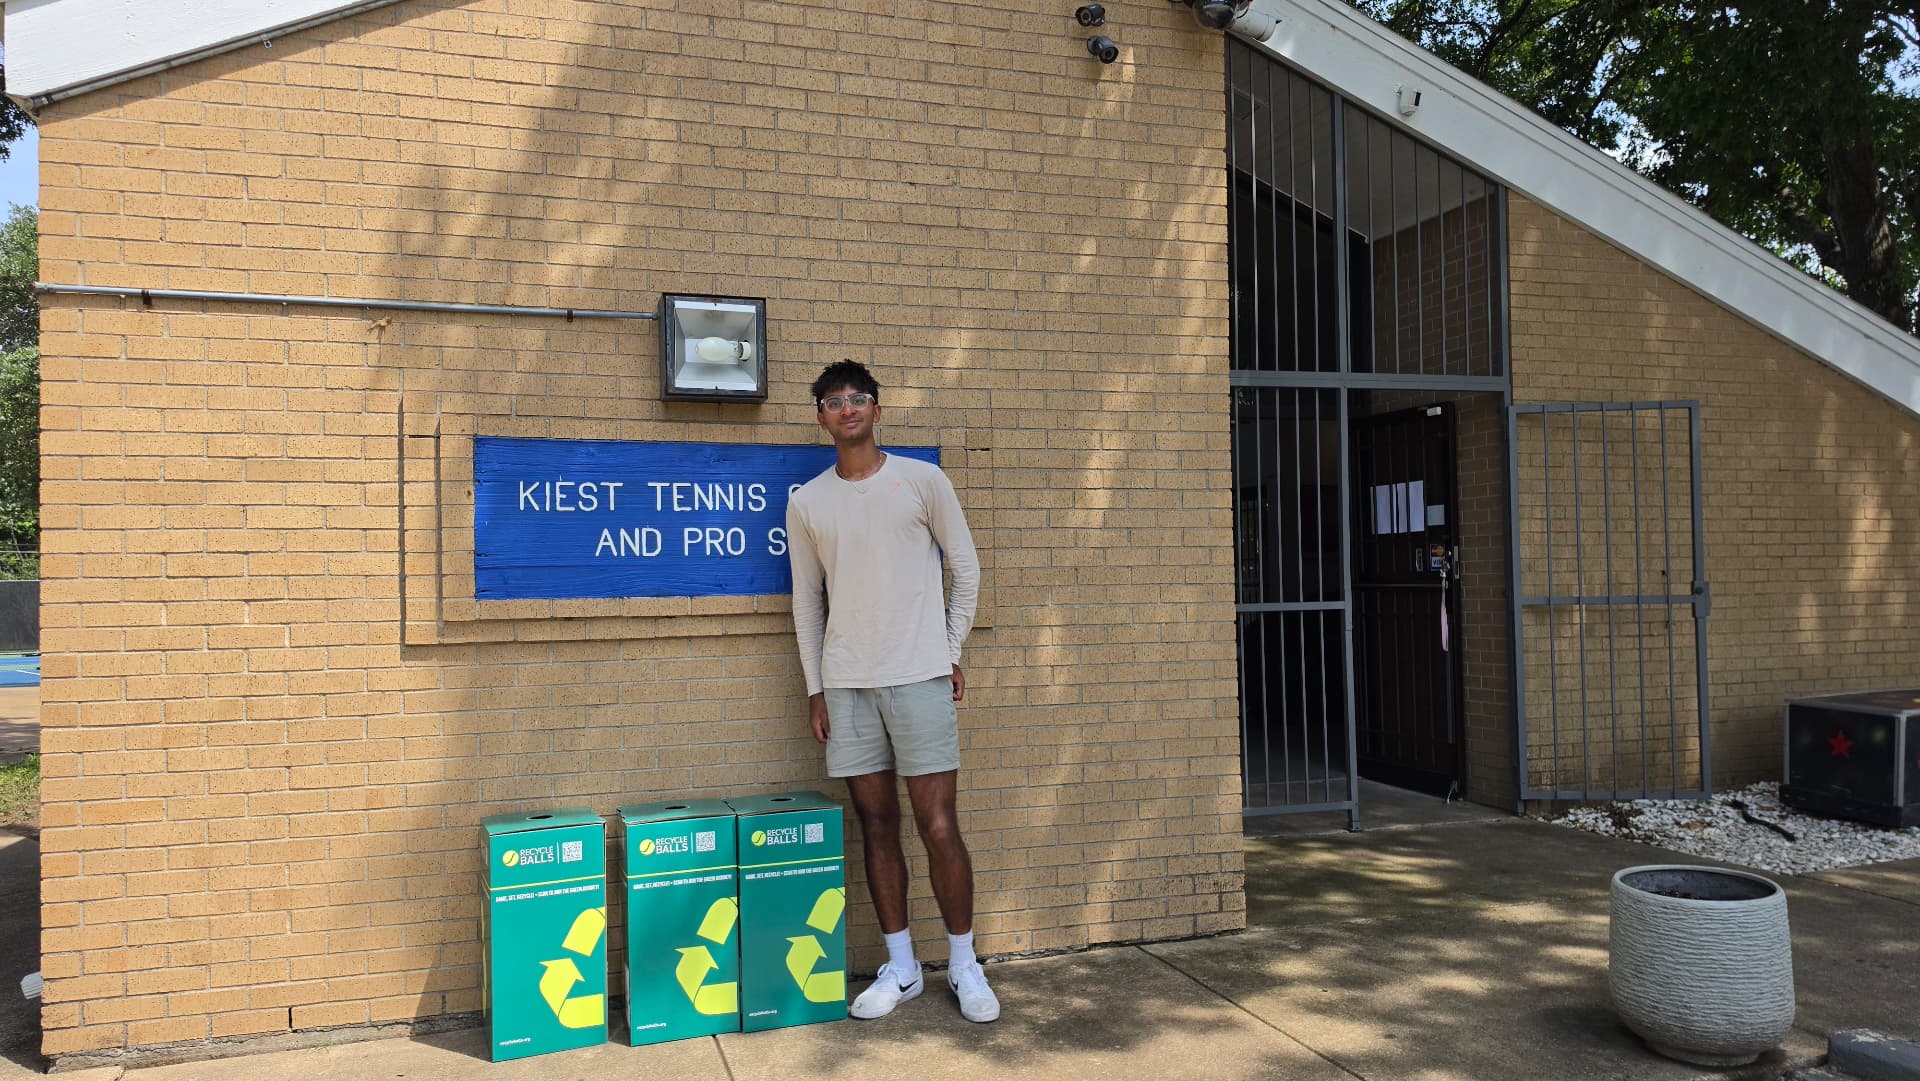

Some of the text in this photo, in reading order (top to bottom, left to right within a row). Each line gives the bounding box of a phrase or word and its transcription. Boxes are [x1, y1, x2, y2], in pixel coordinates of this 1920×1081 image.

[519, 480, 624, 512] KIEST
[647, 482, 767, 512] TENNIS
[595, 527, 662, 557] AND
[683, 526, 746, 557] PRO
[767, 827, 798, 837] RECYCLE
[655, 835, 688, 846] RECYCLE
[767, 834, 798, 846] BALLS
[520, 845, 553, 857] RECYCLE
[655, 843, 689, 854] BALLS
[520, 853, 554, 866] BALLS
